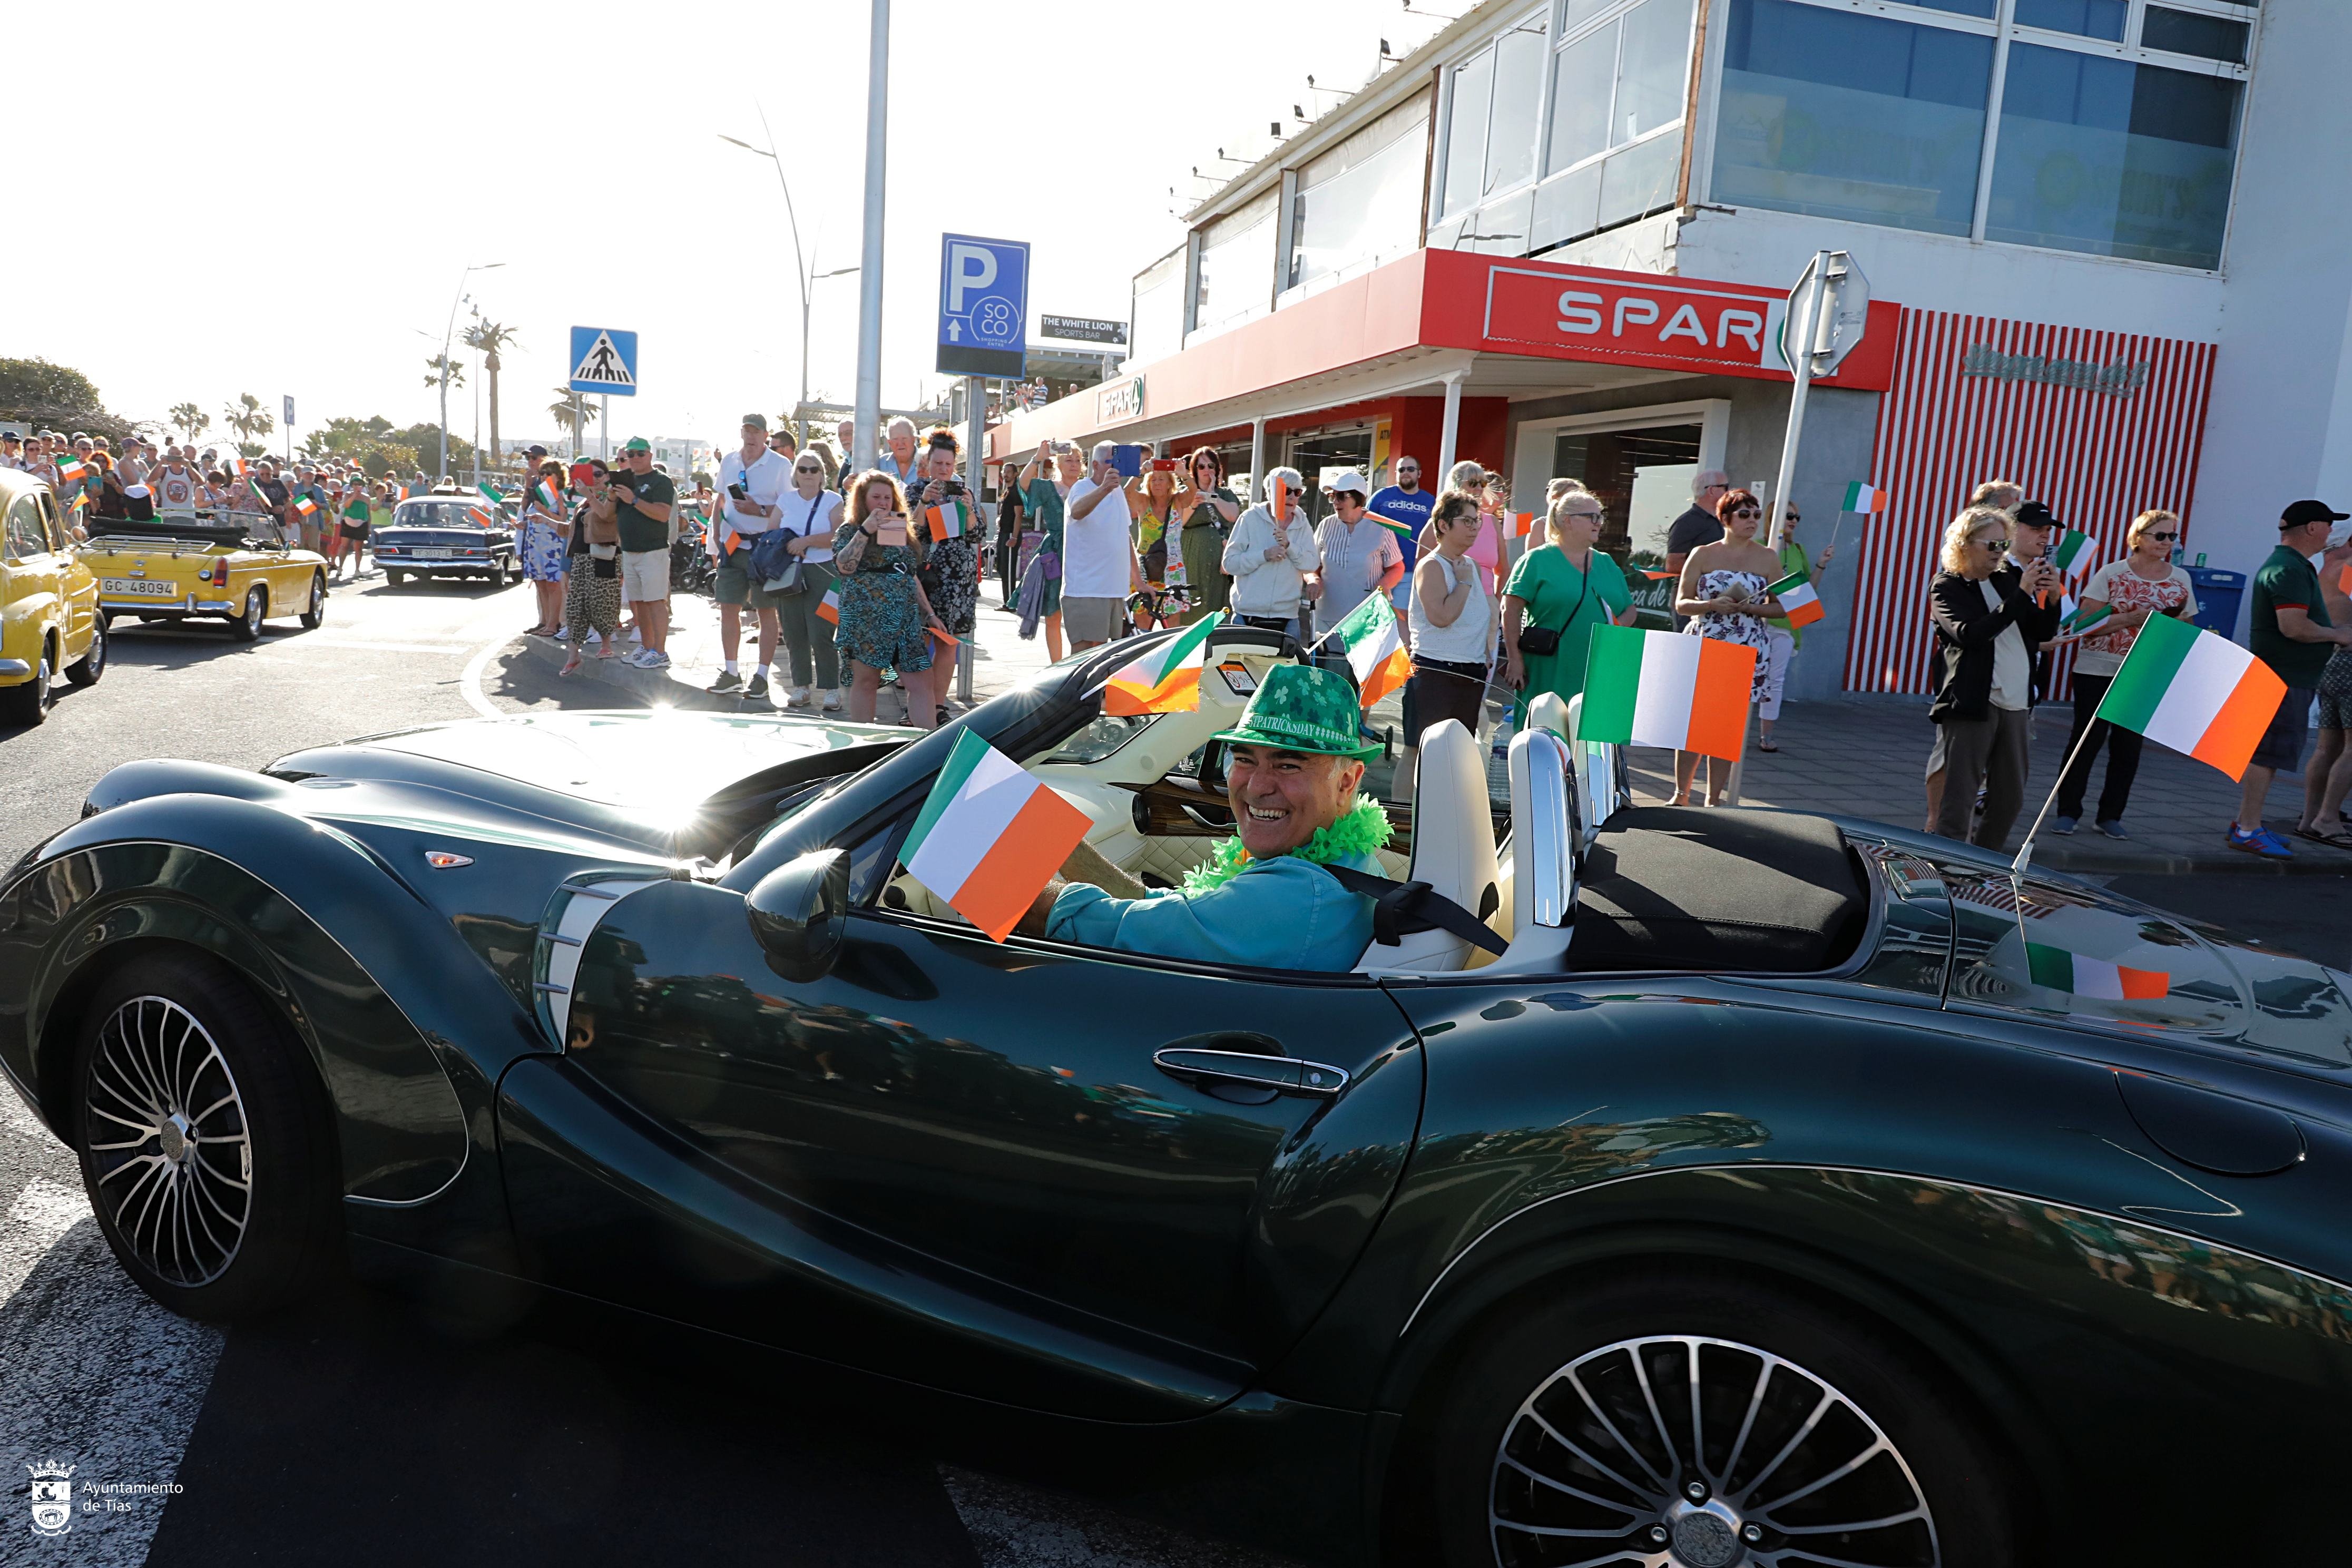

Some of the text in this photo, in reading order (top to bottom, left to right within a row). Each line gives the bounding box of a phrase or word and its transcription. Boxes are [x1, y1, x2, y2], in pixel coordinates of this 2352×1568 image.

[949, 244, 997, 312] P
[984, 303, 1009, 320] SO
[981, 319, 1008, 336] CO
[1043, 317, 1113, 331] THE WHITE LION
[1557, 291, 1762, 351] SPAR
[1055, 328, 1084, 338] SPORTS
[1104, 386, 1132, 416] SPAR
[1388, 500, 1427, 512] adidas
[1648, 580, 1667, 607] de
